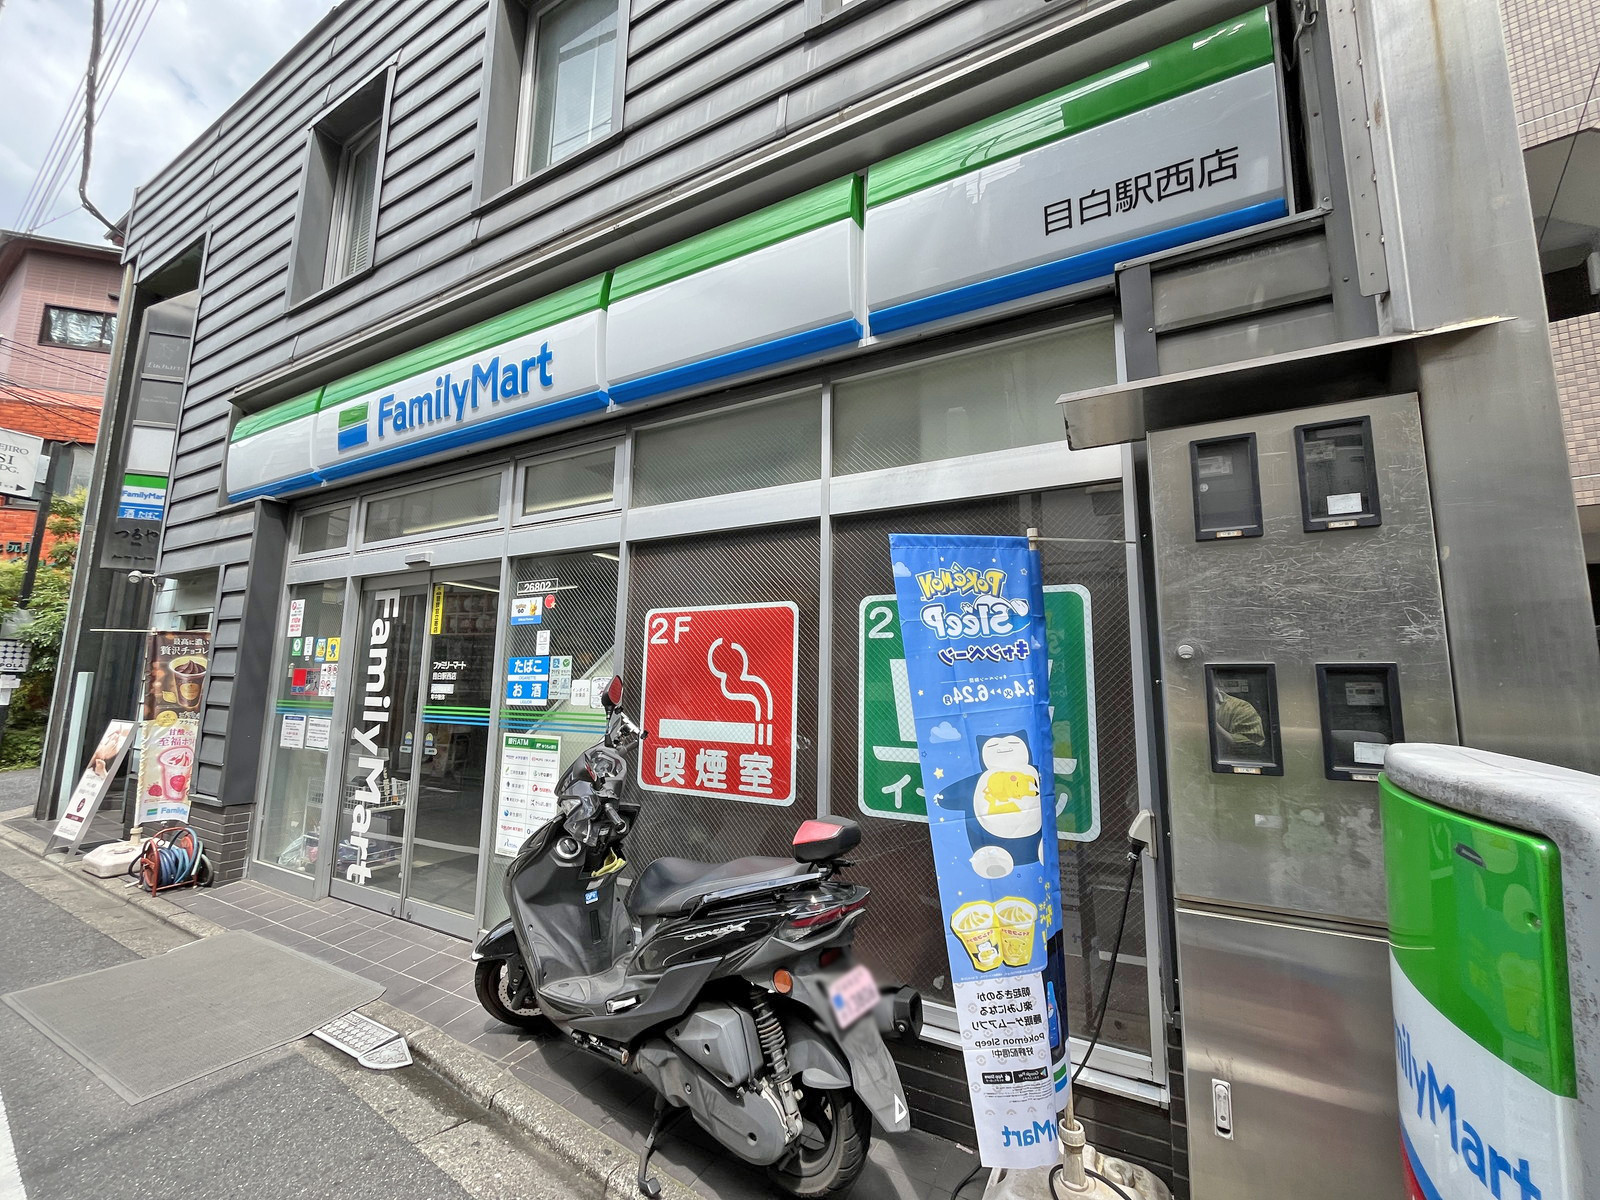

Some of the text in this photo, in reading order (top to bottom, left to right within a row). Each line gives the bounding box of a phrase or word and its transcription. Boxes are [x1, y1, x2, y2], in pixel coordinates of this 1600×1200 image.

[1044, 146, 1239, 236] 目白駅西店
[377, 341, 553, 438] FamilyMart
[650, 616, 692, 645] 2F
[433, 661, 467, 670] ファミリーマート
[514, 659, 543, 673] たばこ
[512, 683, 543, 698] お酒
[345, 589, 400, 885] FamilyMart
[655, 747, 773, 794] 喫煙室
